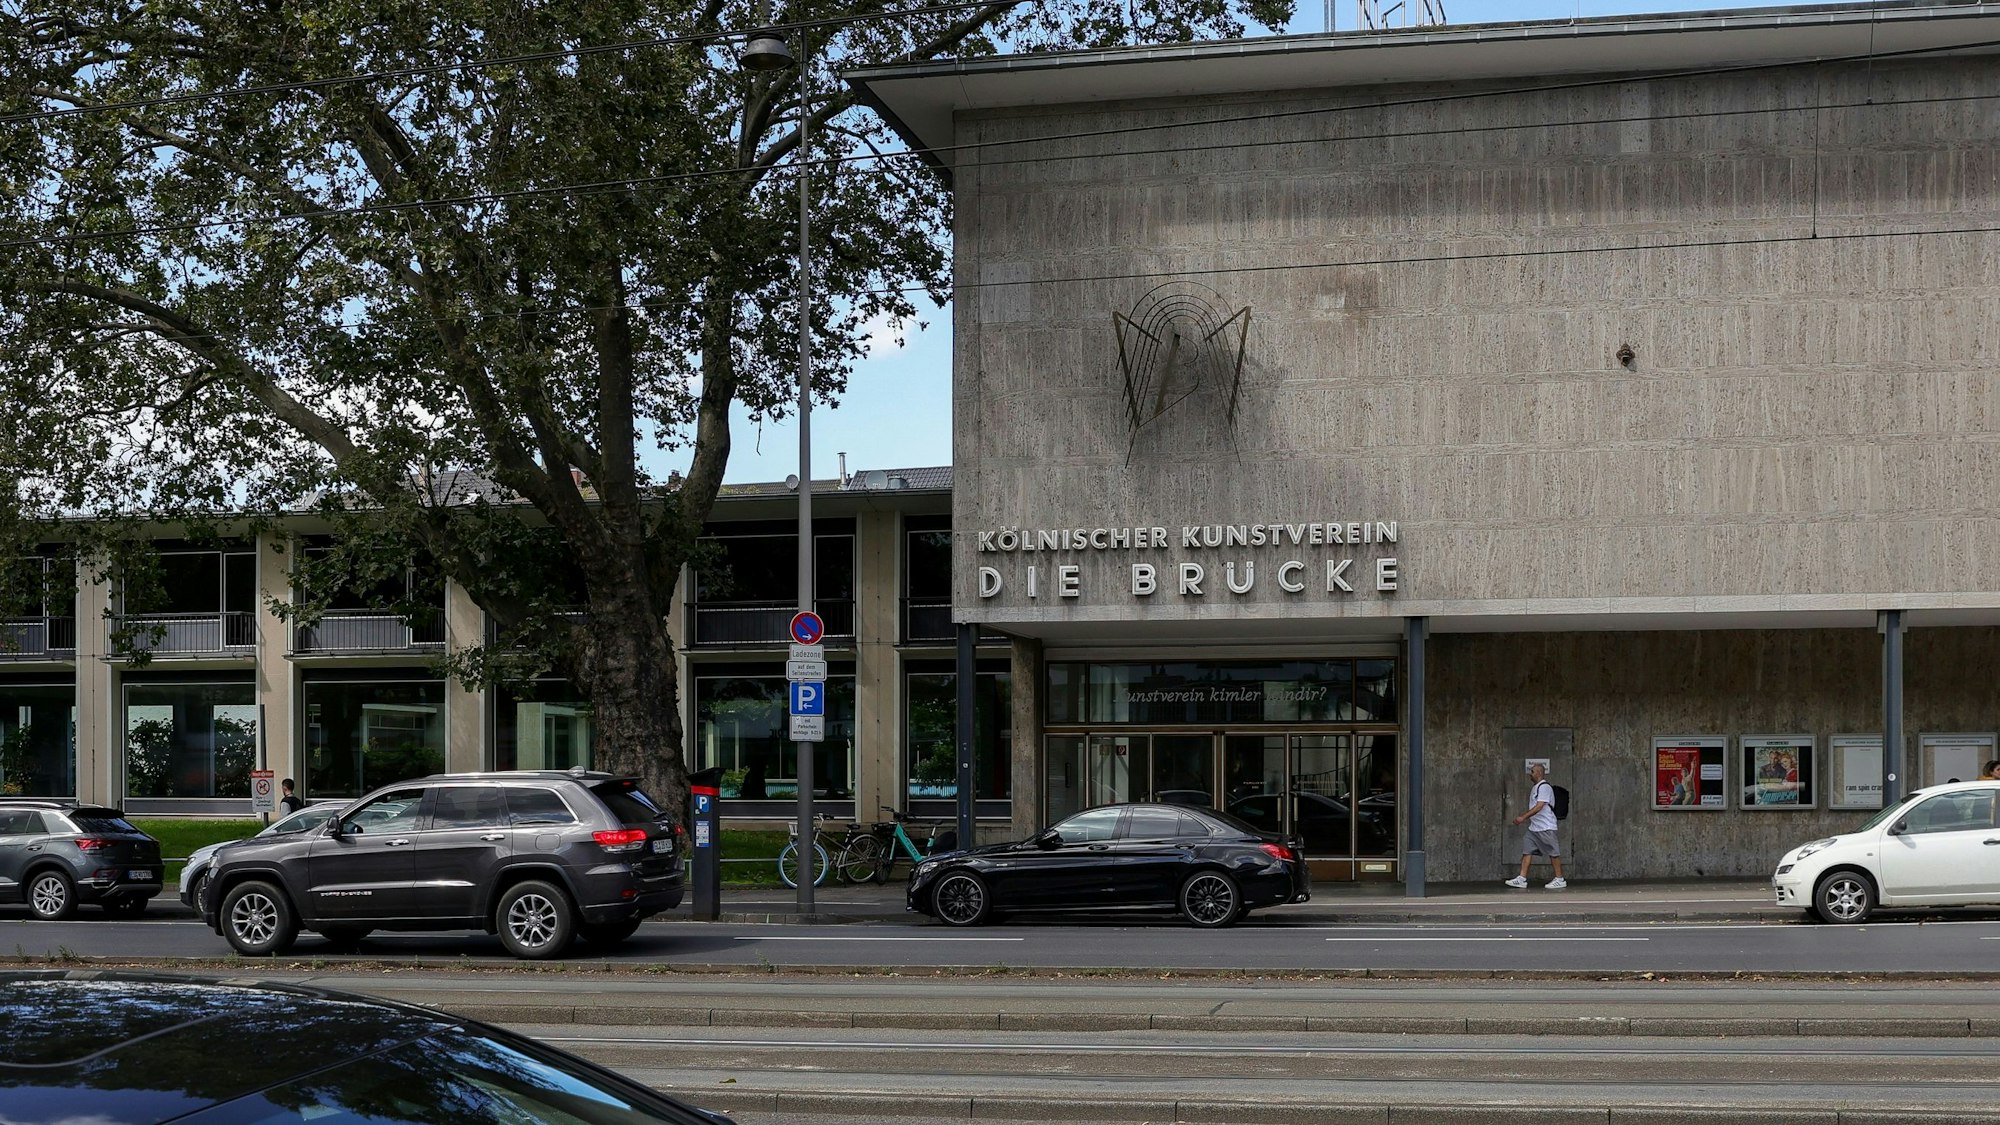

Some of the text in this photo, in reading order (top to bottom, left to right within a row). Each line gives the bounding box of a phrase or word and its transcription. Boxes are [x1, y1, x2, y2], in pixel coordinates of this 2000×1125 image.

[978, 521, 1399, 552] KÖLNISCHER KUNSTVEREIN
[978, 557, 1399, 598] DIE BRÜCKE
[792, 649, 822, 659] Ladezone
[798, 686, 816, 711] P
[1209, 686, 1261, 702] kimler
[1858, 783, 1870, 793] spin
[699, 796, 708, 810] P
